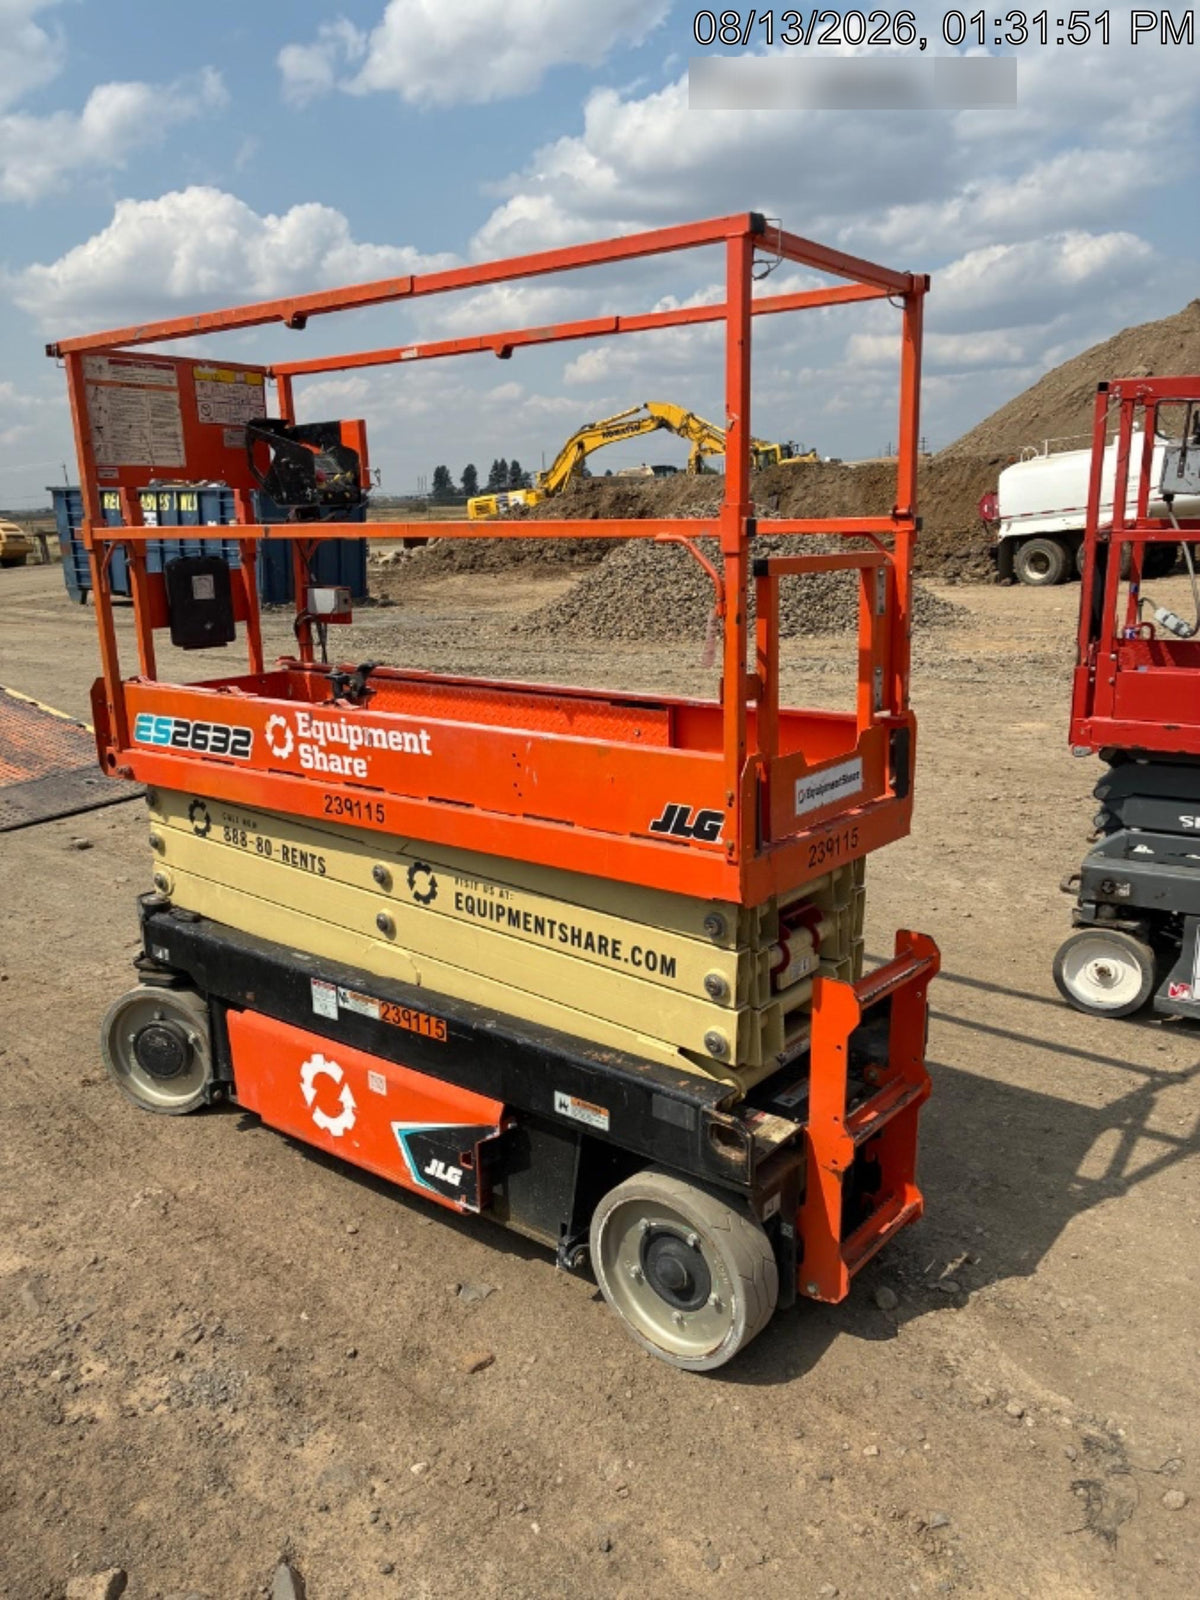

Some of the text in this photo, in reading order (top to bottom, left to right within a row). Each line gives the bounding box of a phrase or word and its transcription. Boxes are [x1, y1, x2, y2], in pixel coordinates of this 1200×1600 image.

[134, 712, 253, 760] ES2632
[295, 711, 432, 756] Equipment
[298, 743, 368, 778] Share
[805, 770, 860, 799] EquipmentShare
[323, 793, 386, 824] 239115
[650, 801, 726, 842] JLG
[222, 825, 327, 874] 888-80-RENTS
[808, 826, 859, 868] 239115
[454, 891, 677, 979] EQUIPMENTSHARE.COM
[380, 1001, 446, 1039] 239115
[423, 1158, 464, 1187] JLG
